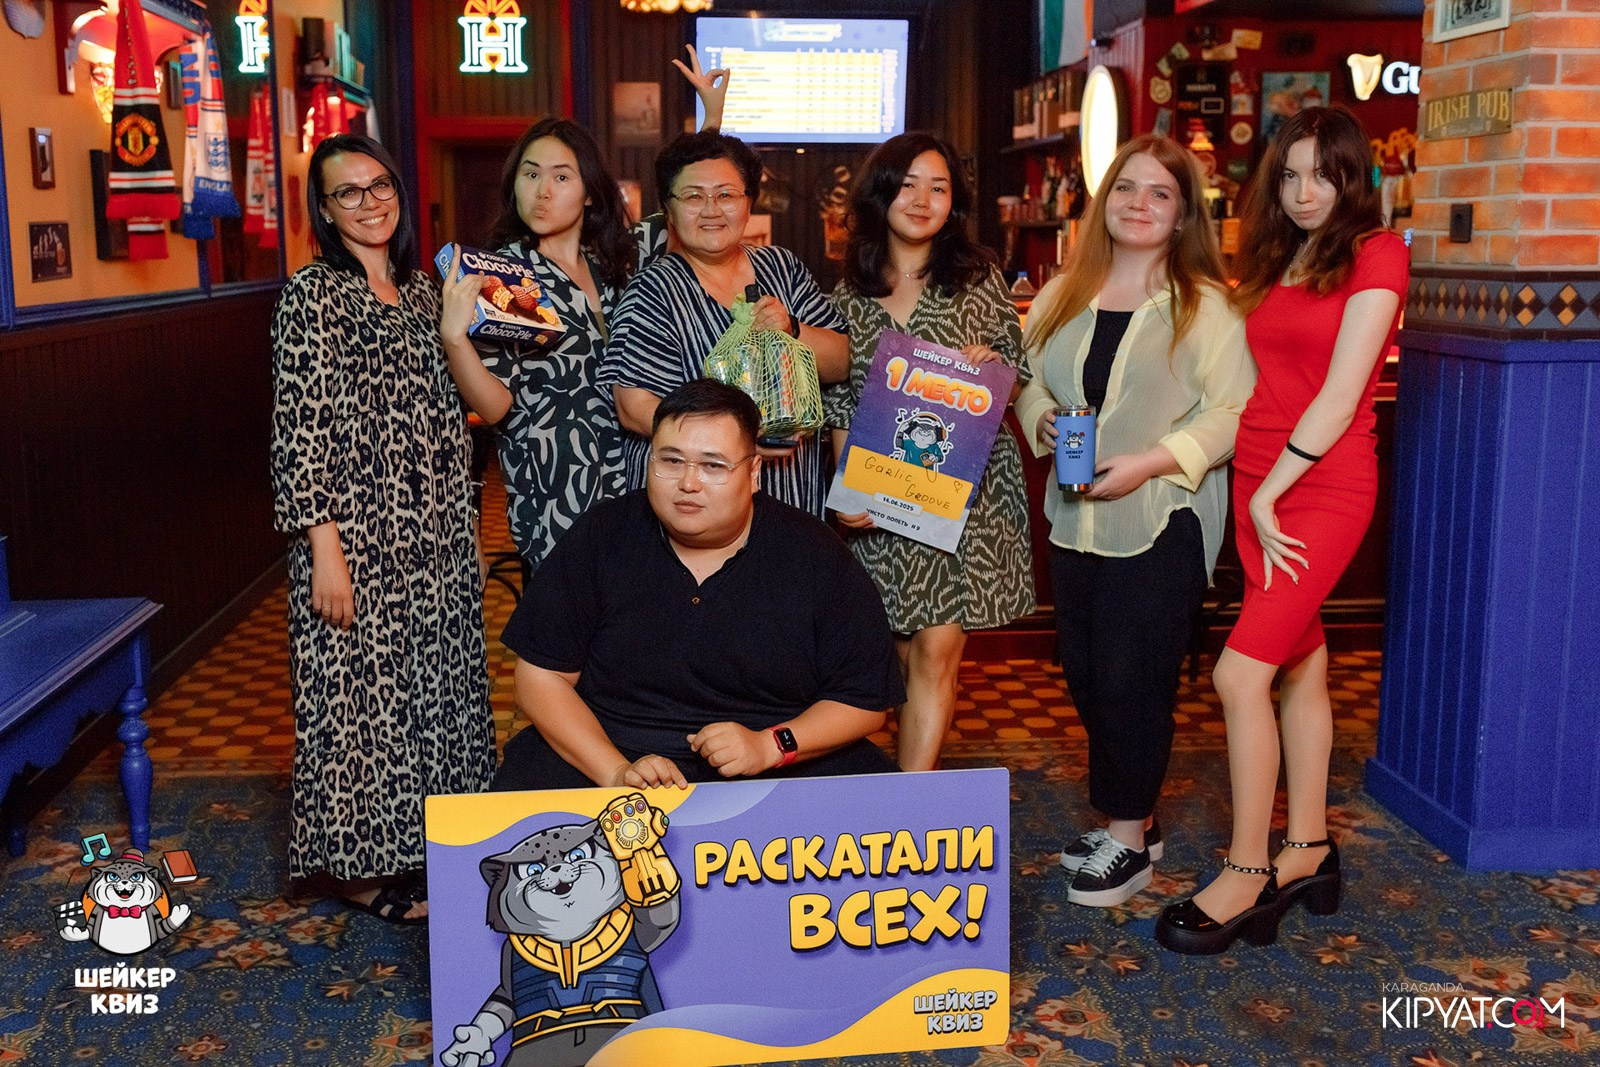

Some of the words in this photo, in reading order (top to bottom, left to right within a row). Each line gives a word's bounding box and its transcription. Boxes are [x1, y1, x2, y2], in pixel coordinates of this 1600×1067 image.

[1428, 95, 1470, 131] IRISH
[1477, 89, 1510, 121] PUB
[913, 347, 952, 366] ШЕЙКЕР
[954, 361, 981, 376] КВИЗ
[886, 357, 908, 390] 1
[903, 368, 992, 416] МЕСТО
[886, 515, 909, 527] ПОПЕТЬ
[694, 825, 994, 888] РАСКАТАЛИ
[789, 883, 988, 952] ВСЕХ!
[914, 988, 997, 1014] ШЕЙКЕР
[927, 1012, 983, 1035] КВИЗ
